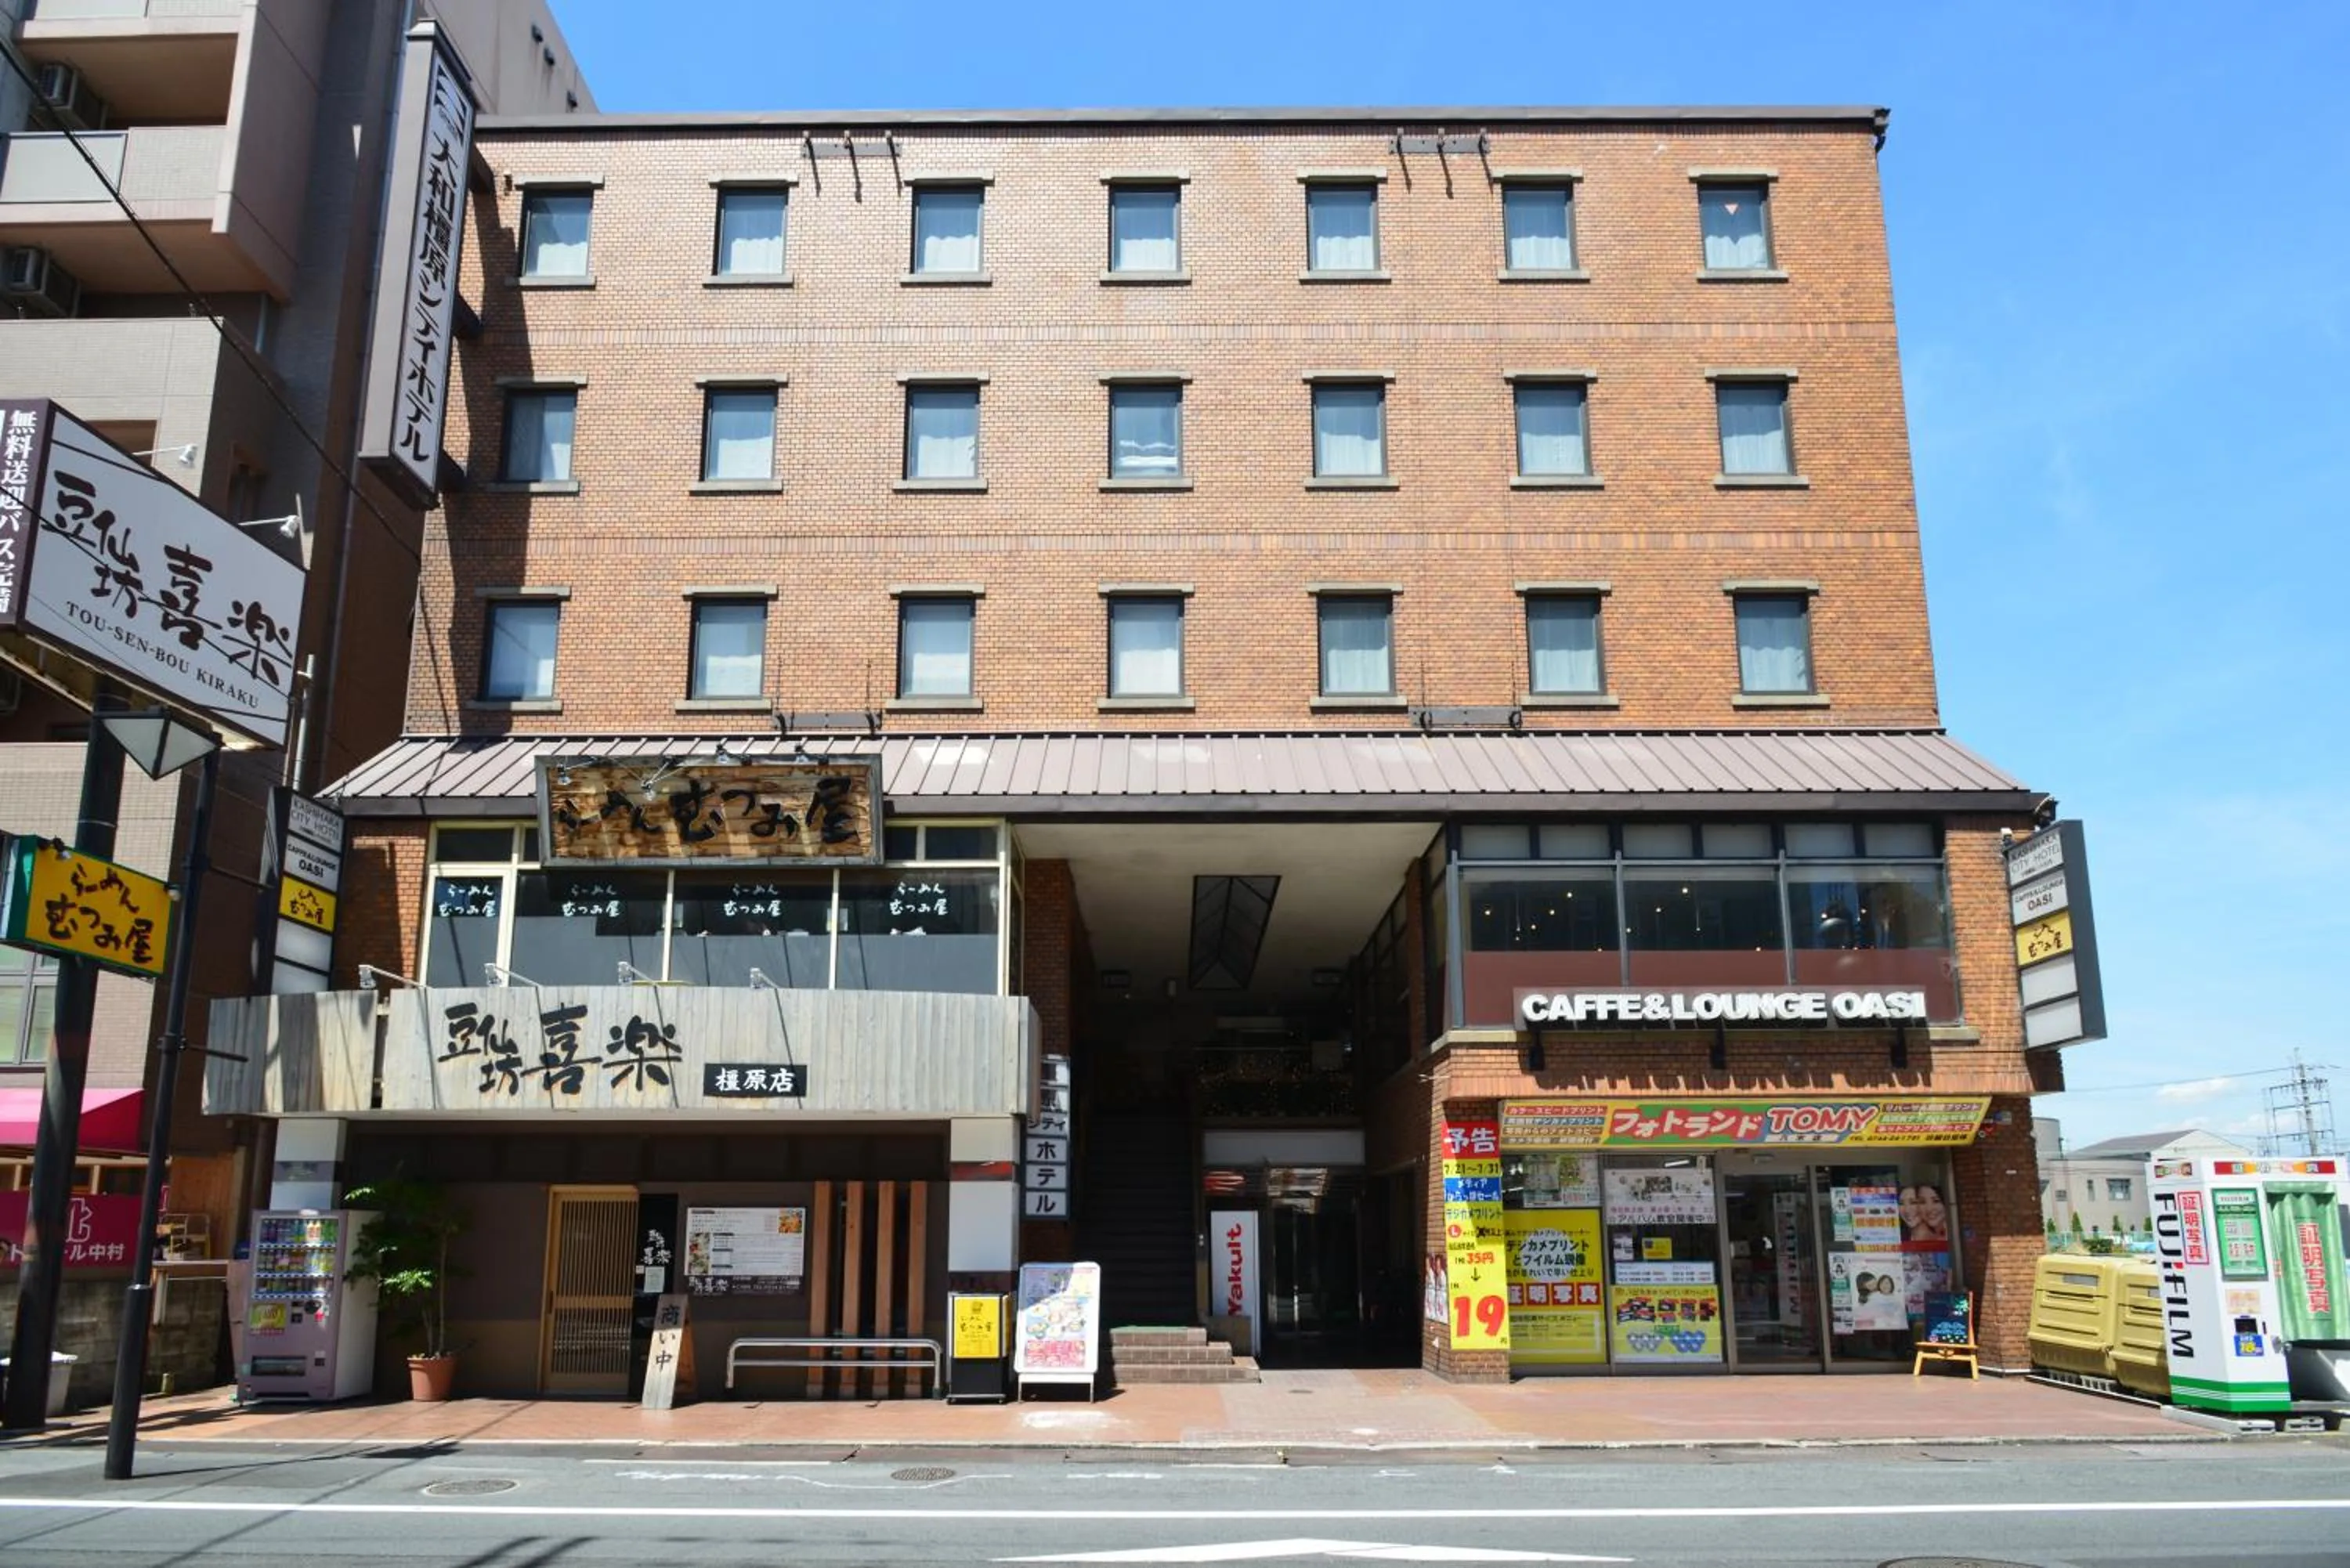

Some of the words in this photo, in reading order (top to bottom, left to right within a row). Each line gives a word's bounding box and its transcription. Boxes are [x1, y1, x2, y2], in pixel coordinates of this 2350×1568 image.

[401, 132, 457, 462] 大和橿原シティホテル
[66, 600, 190, 675] TOU-SEN-BOU
[196, 668, 259, 710] KIRAKU
[298, 859, 324, 879] OASI
[439, 900, 496, 918] むつみ屋
[561, 900, 620, 918] むつみ屋
[723, 899, 782, 917] むつみ屋
[889, 898, 949, 916] むつみ屋
[2027, 892, 2053, 911] OASI
[45, 893, 155, 964] むつみ屋
[1521, 992, 1828, 1021] CAFFE&LOUNGE
[1831, 991, 1927, 1019] OASI
[714, 1068, 795, 1093] 橿原店
[1613, 1109, 1763, 1137] フォトランド
[1766, 1105, 1880, 1133] TOMY
[1444, 1127, 1496, 1154] 予告
[1456, 1179, 1488, 1189] メディア
[1466, 1252, 1495, 1264] 35円
[1506, 1239, 1590, 1252] デジカメプリント
[1226, 1223, 1244, 1317] Yakult
[2154, 1192, 2194, 1359] FUJIFILM
[2298, 1222, 2331, 1315] 証明写真
[1453, 1295, 1506, 1337] 19
[656, 1304, 681, 1373] 商い中
